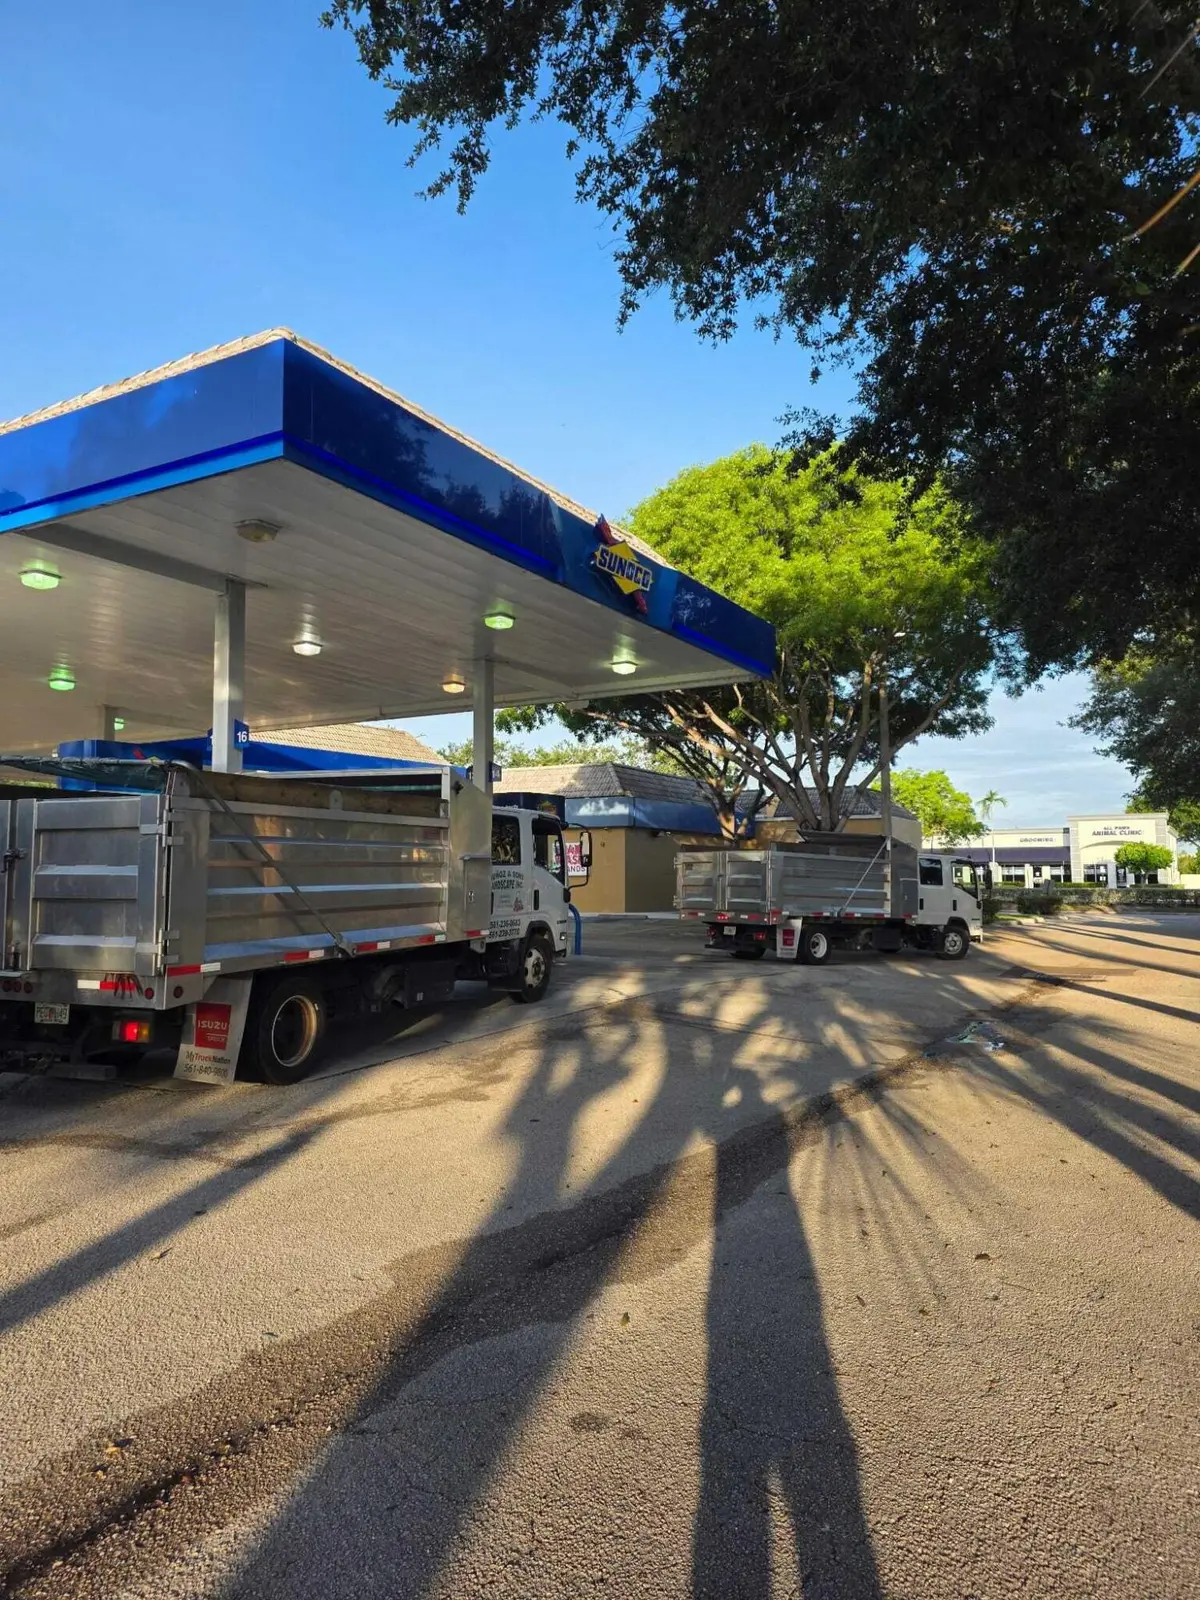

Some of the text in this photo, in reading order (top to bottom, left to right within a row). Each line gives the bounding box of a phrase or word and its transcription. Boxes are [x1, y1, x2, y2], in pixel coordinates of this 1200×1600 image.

[598, 547, 651, 589] SUNOCO
[236, 730, 248, 743] 16
[197, 1020, 228, 1030] ISUZU
